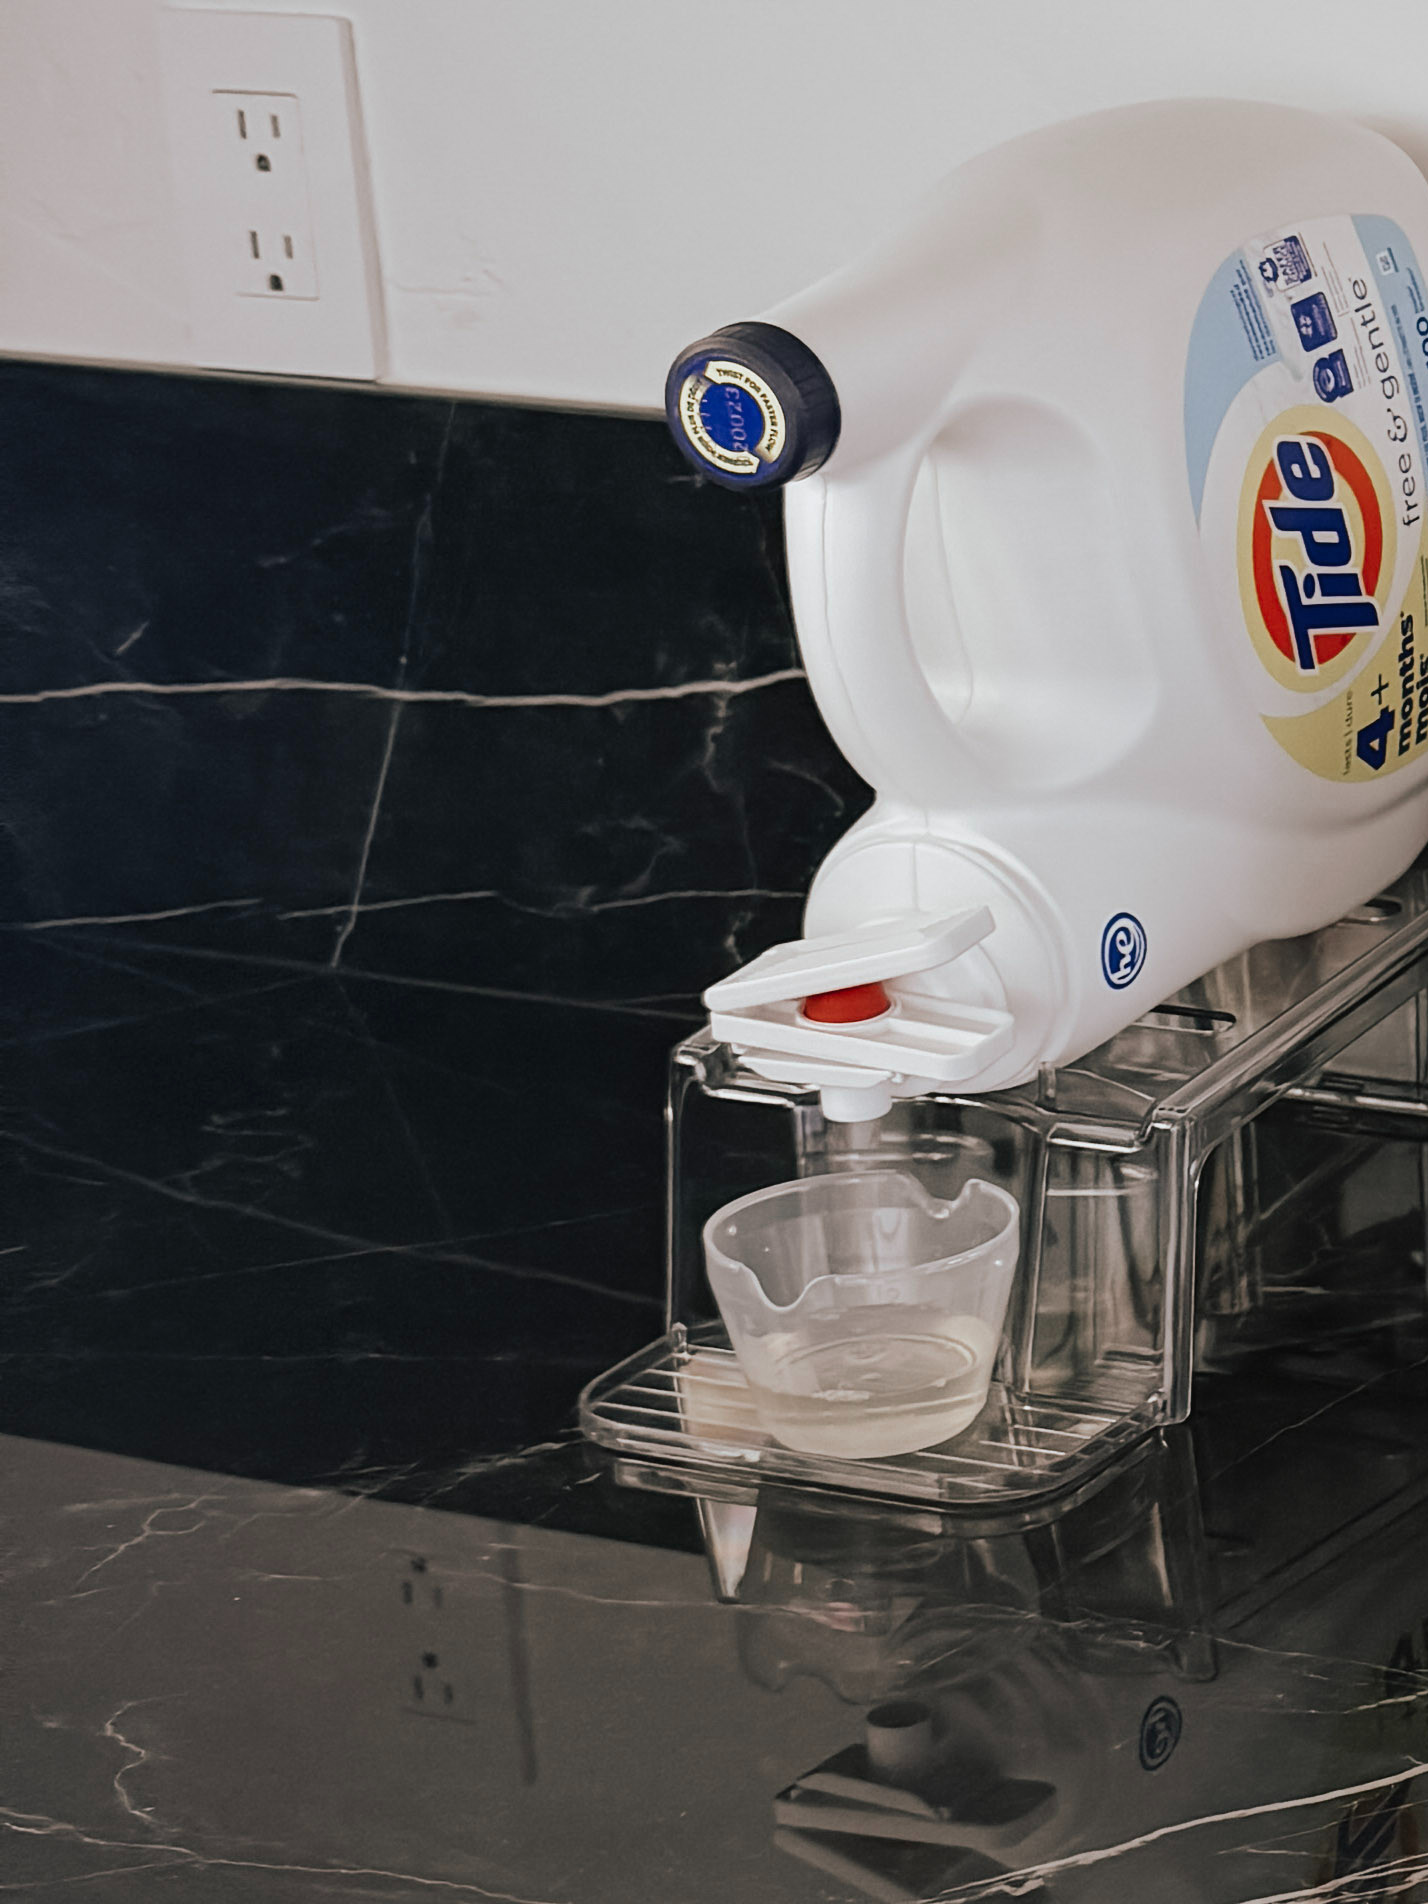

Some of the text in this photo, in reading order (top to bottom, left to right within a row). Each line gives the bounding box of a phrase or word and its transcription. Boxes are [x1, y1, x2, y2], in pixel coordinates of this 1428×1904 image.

[1351, 278, 1400, 400] gentle
[744, 377, 762, 393] FOR
[760, 393, 779, 426] FASTER
[1386, 408, 1408, 444] &
[1397, 453, 1420, 527] free
[1268, 438, 1380, 672] Tide
